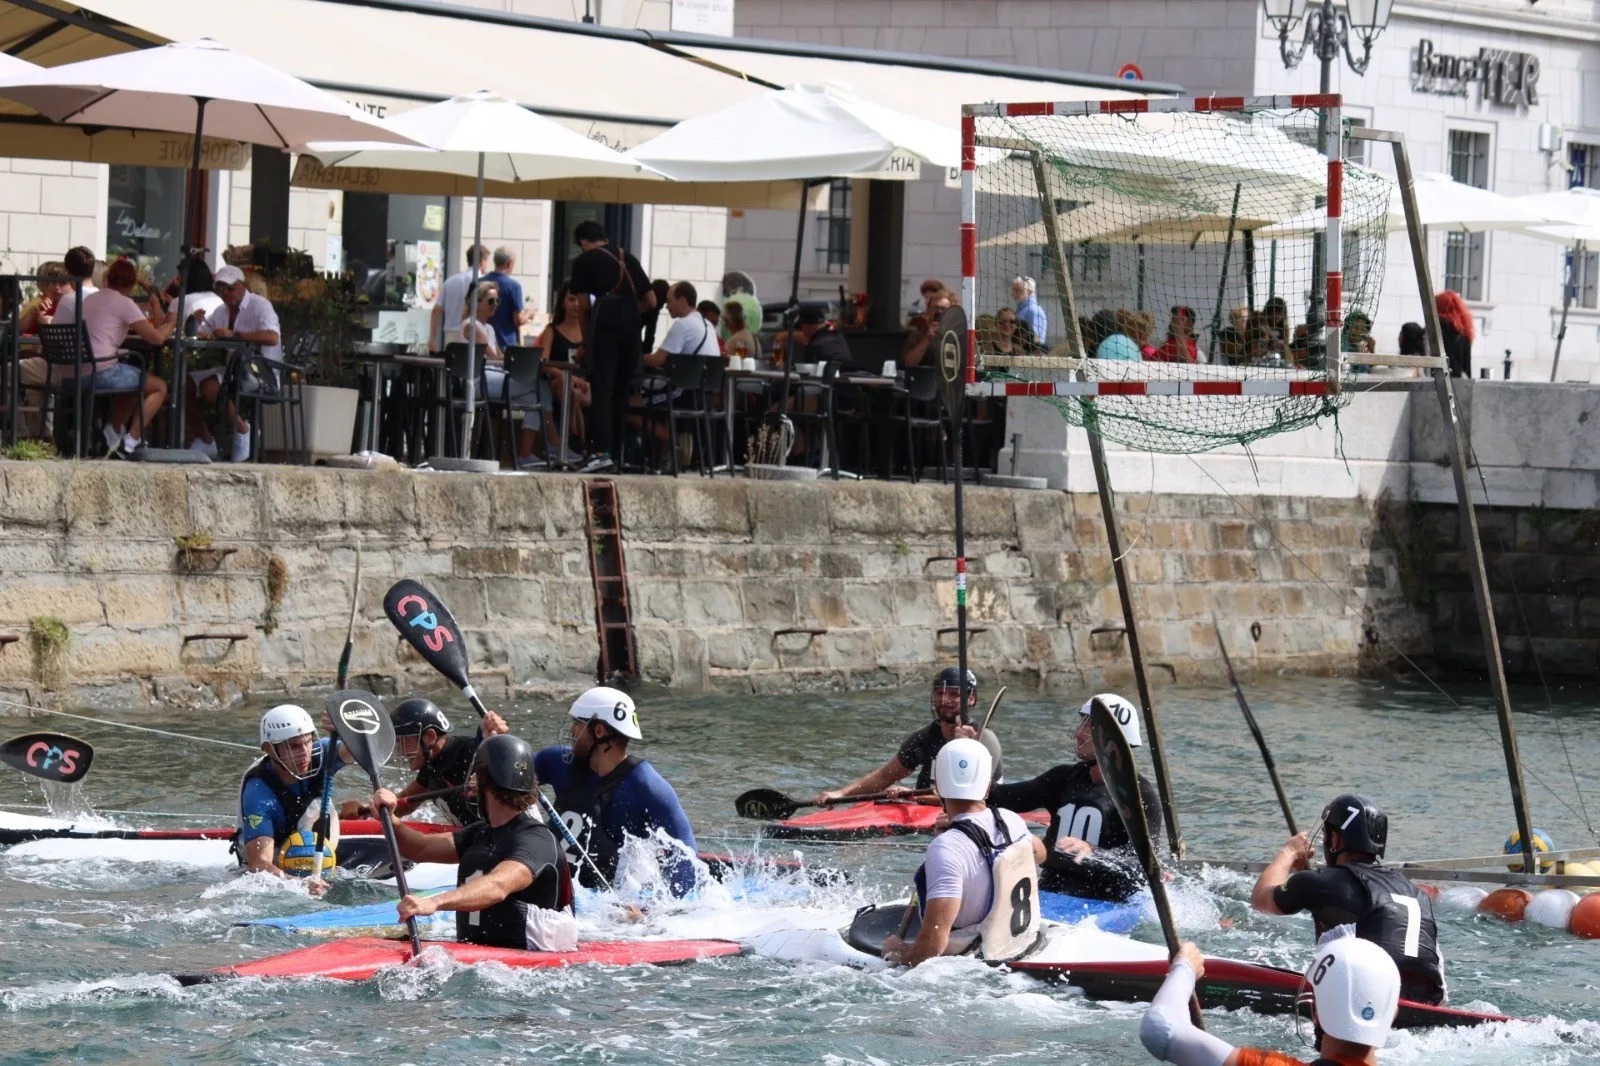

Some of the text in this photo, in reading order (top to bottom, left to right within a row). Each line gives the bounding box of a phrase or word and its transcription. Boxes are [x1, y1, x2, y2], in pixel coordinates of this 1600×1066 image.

[397, 594, 454, 652] CPS
[436, 710, 450, 731] 8
[613, 701, 628, 721] 6
[1109, 703, 1132, 726] 10
[26, 741, 80, 775] CPS
[1054, 802, 1103, 852] 10
[1340, 805, 1360, 831] 7
[1009, 876, 1032, 938] 8
[1390, 892, 1422, 958] 7
[1313, 953, 1336, 986] 6
